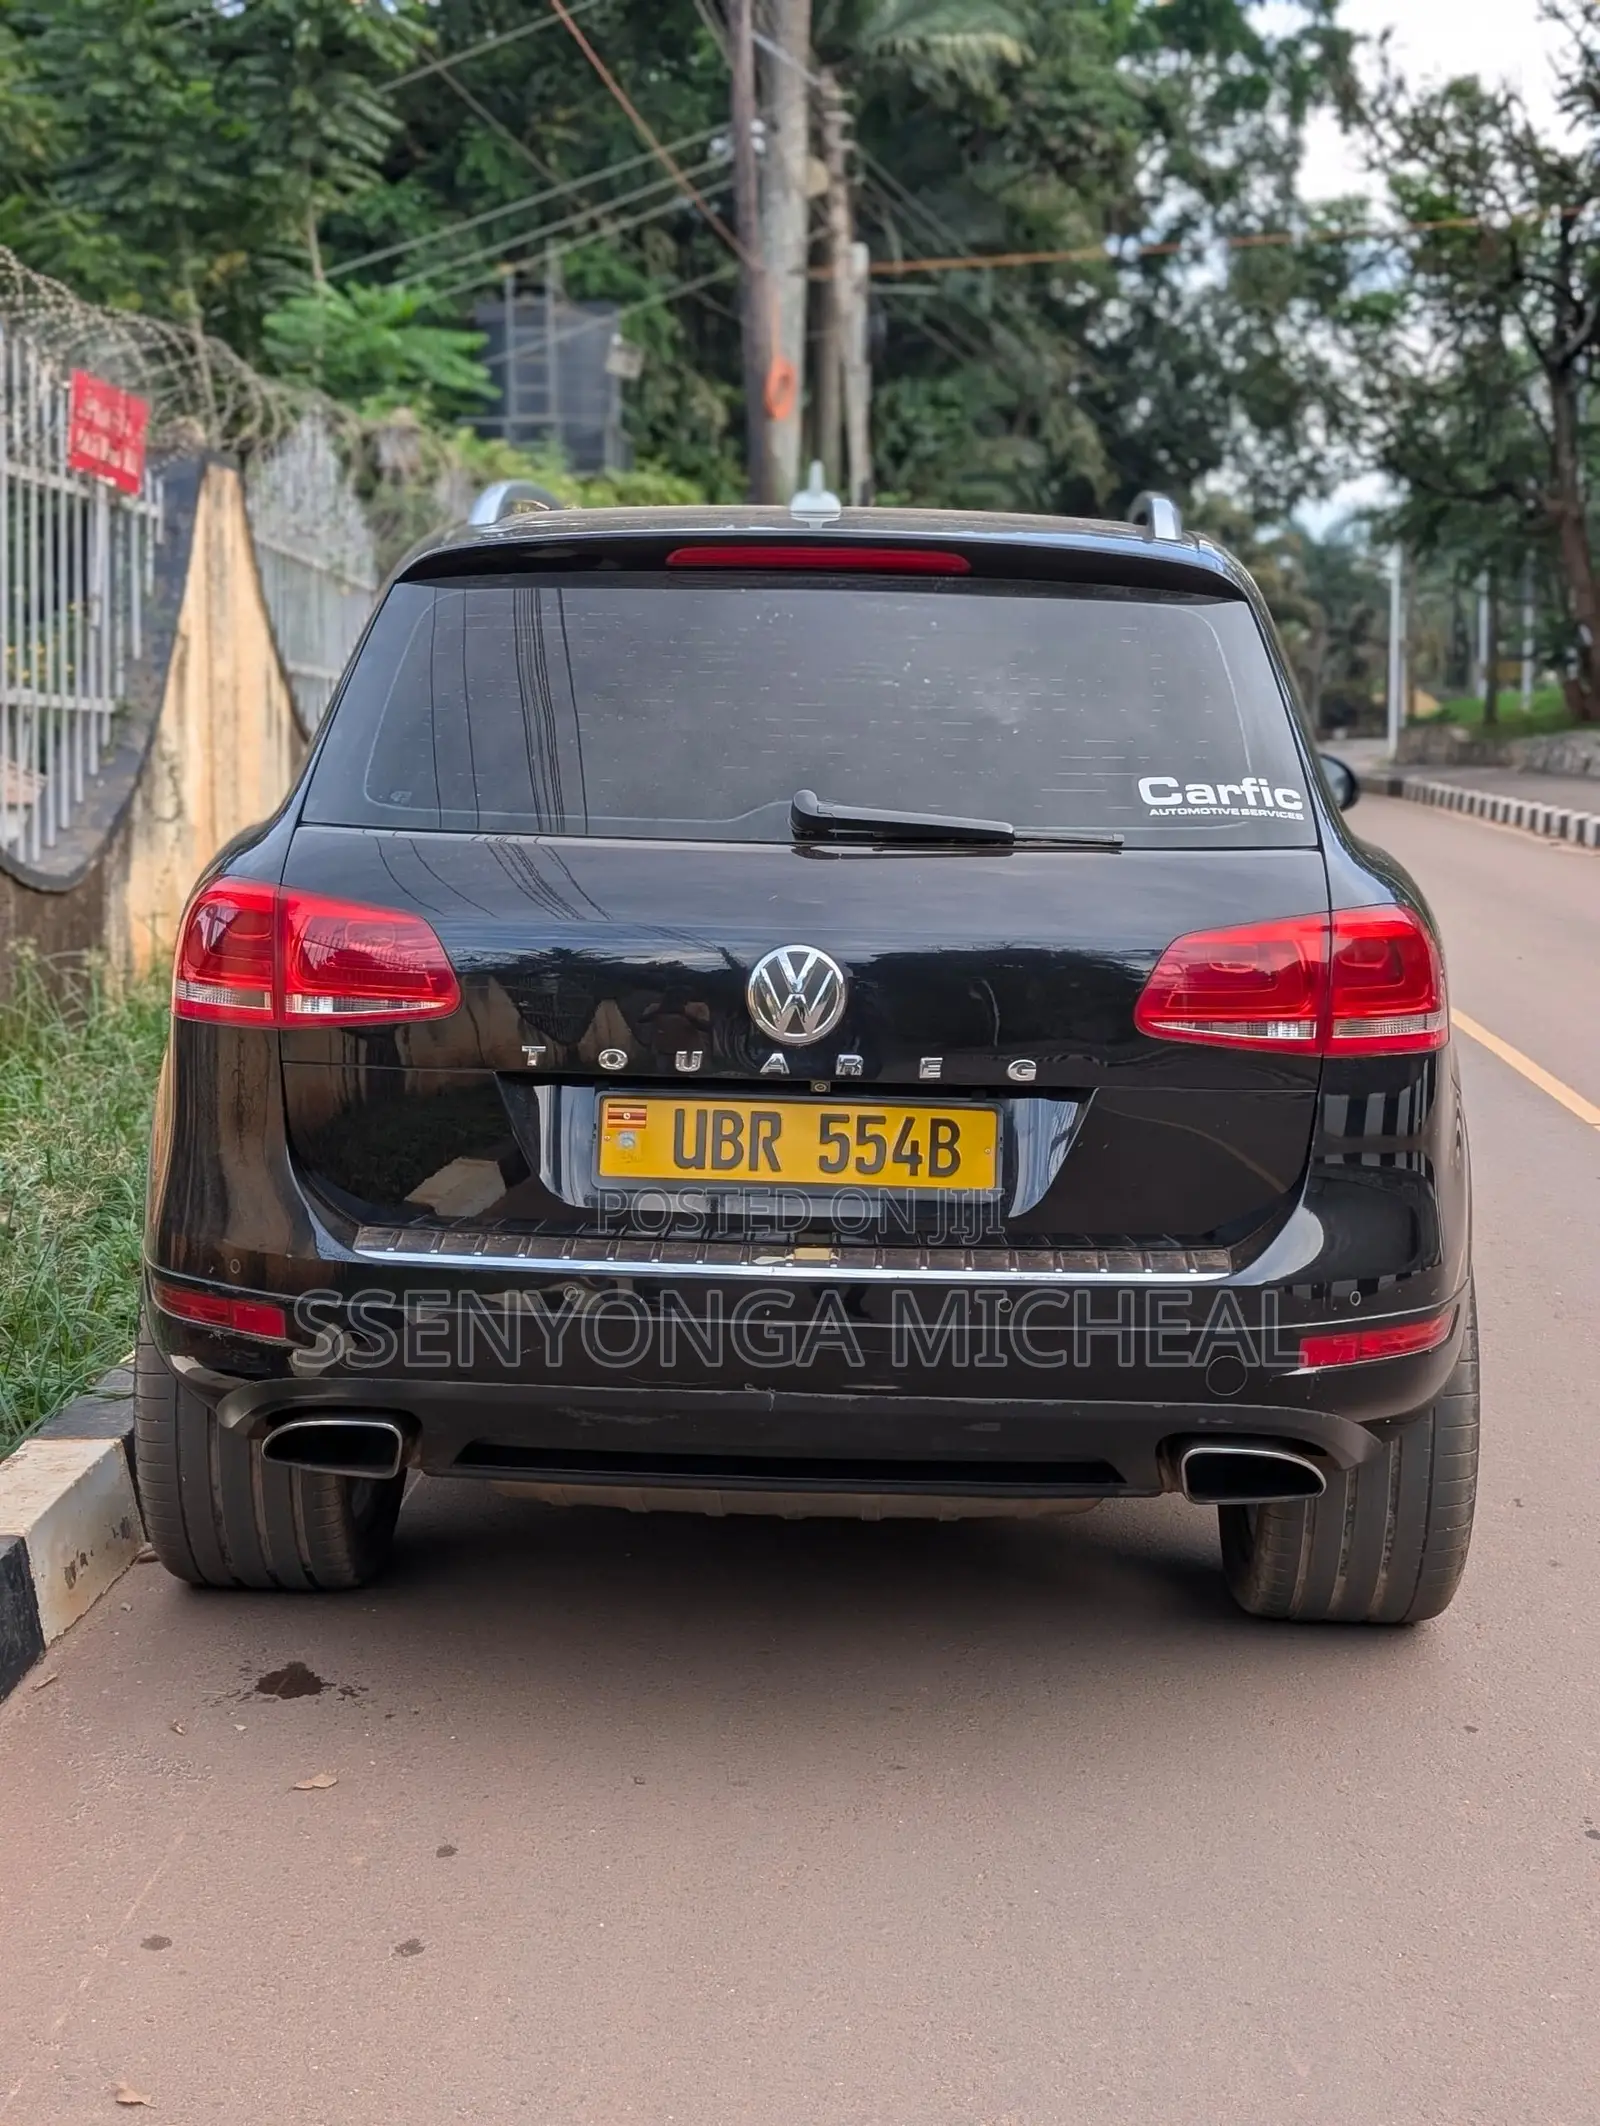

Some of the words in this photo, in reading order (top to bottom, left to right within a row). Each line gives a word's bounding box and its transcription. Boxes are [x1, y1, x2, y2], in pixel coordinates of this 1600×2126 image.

[1138, 777, 1303, 809] Carfic
[1150, 807, 1240, 816] AUTOMOTIVE
[1241, 808, 1304, 820] SERVICES
[750, 946, 846, 1043] VW
[521, 1045, 1037, 1082] TOUAREG
[673, 1108, 782, 1172] UBR
[818, 1113, 961, 1178] 554B
